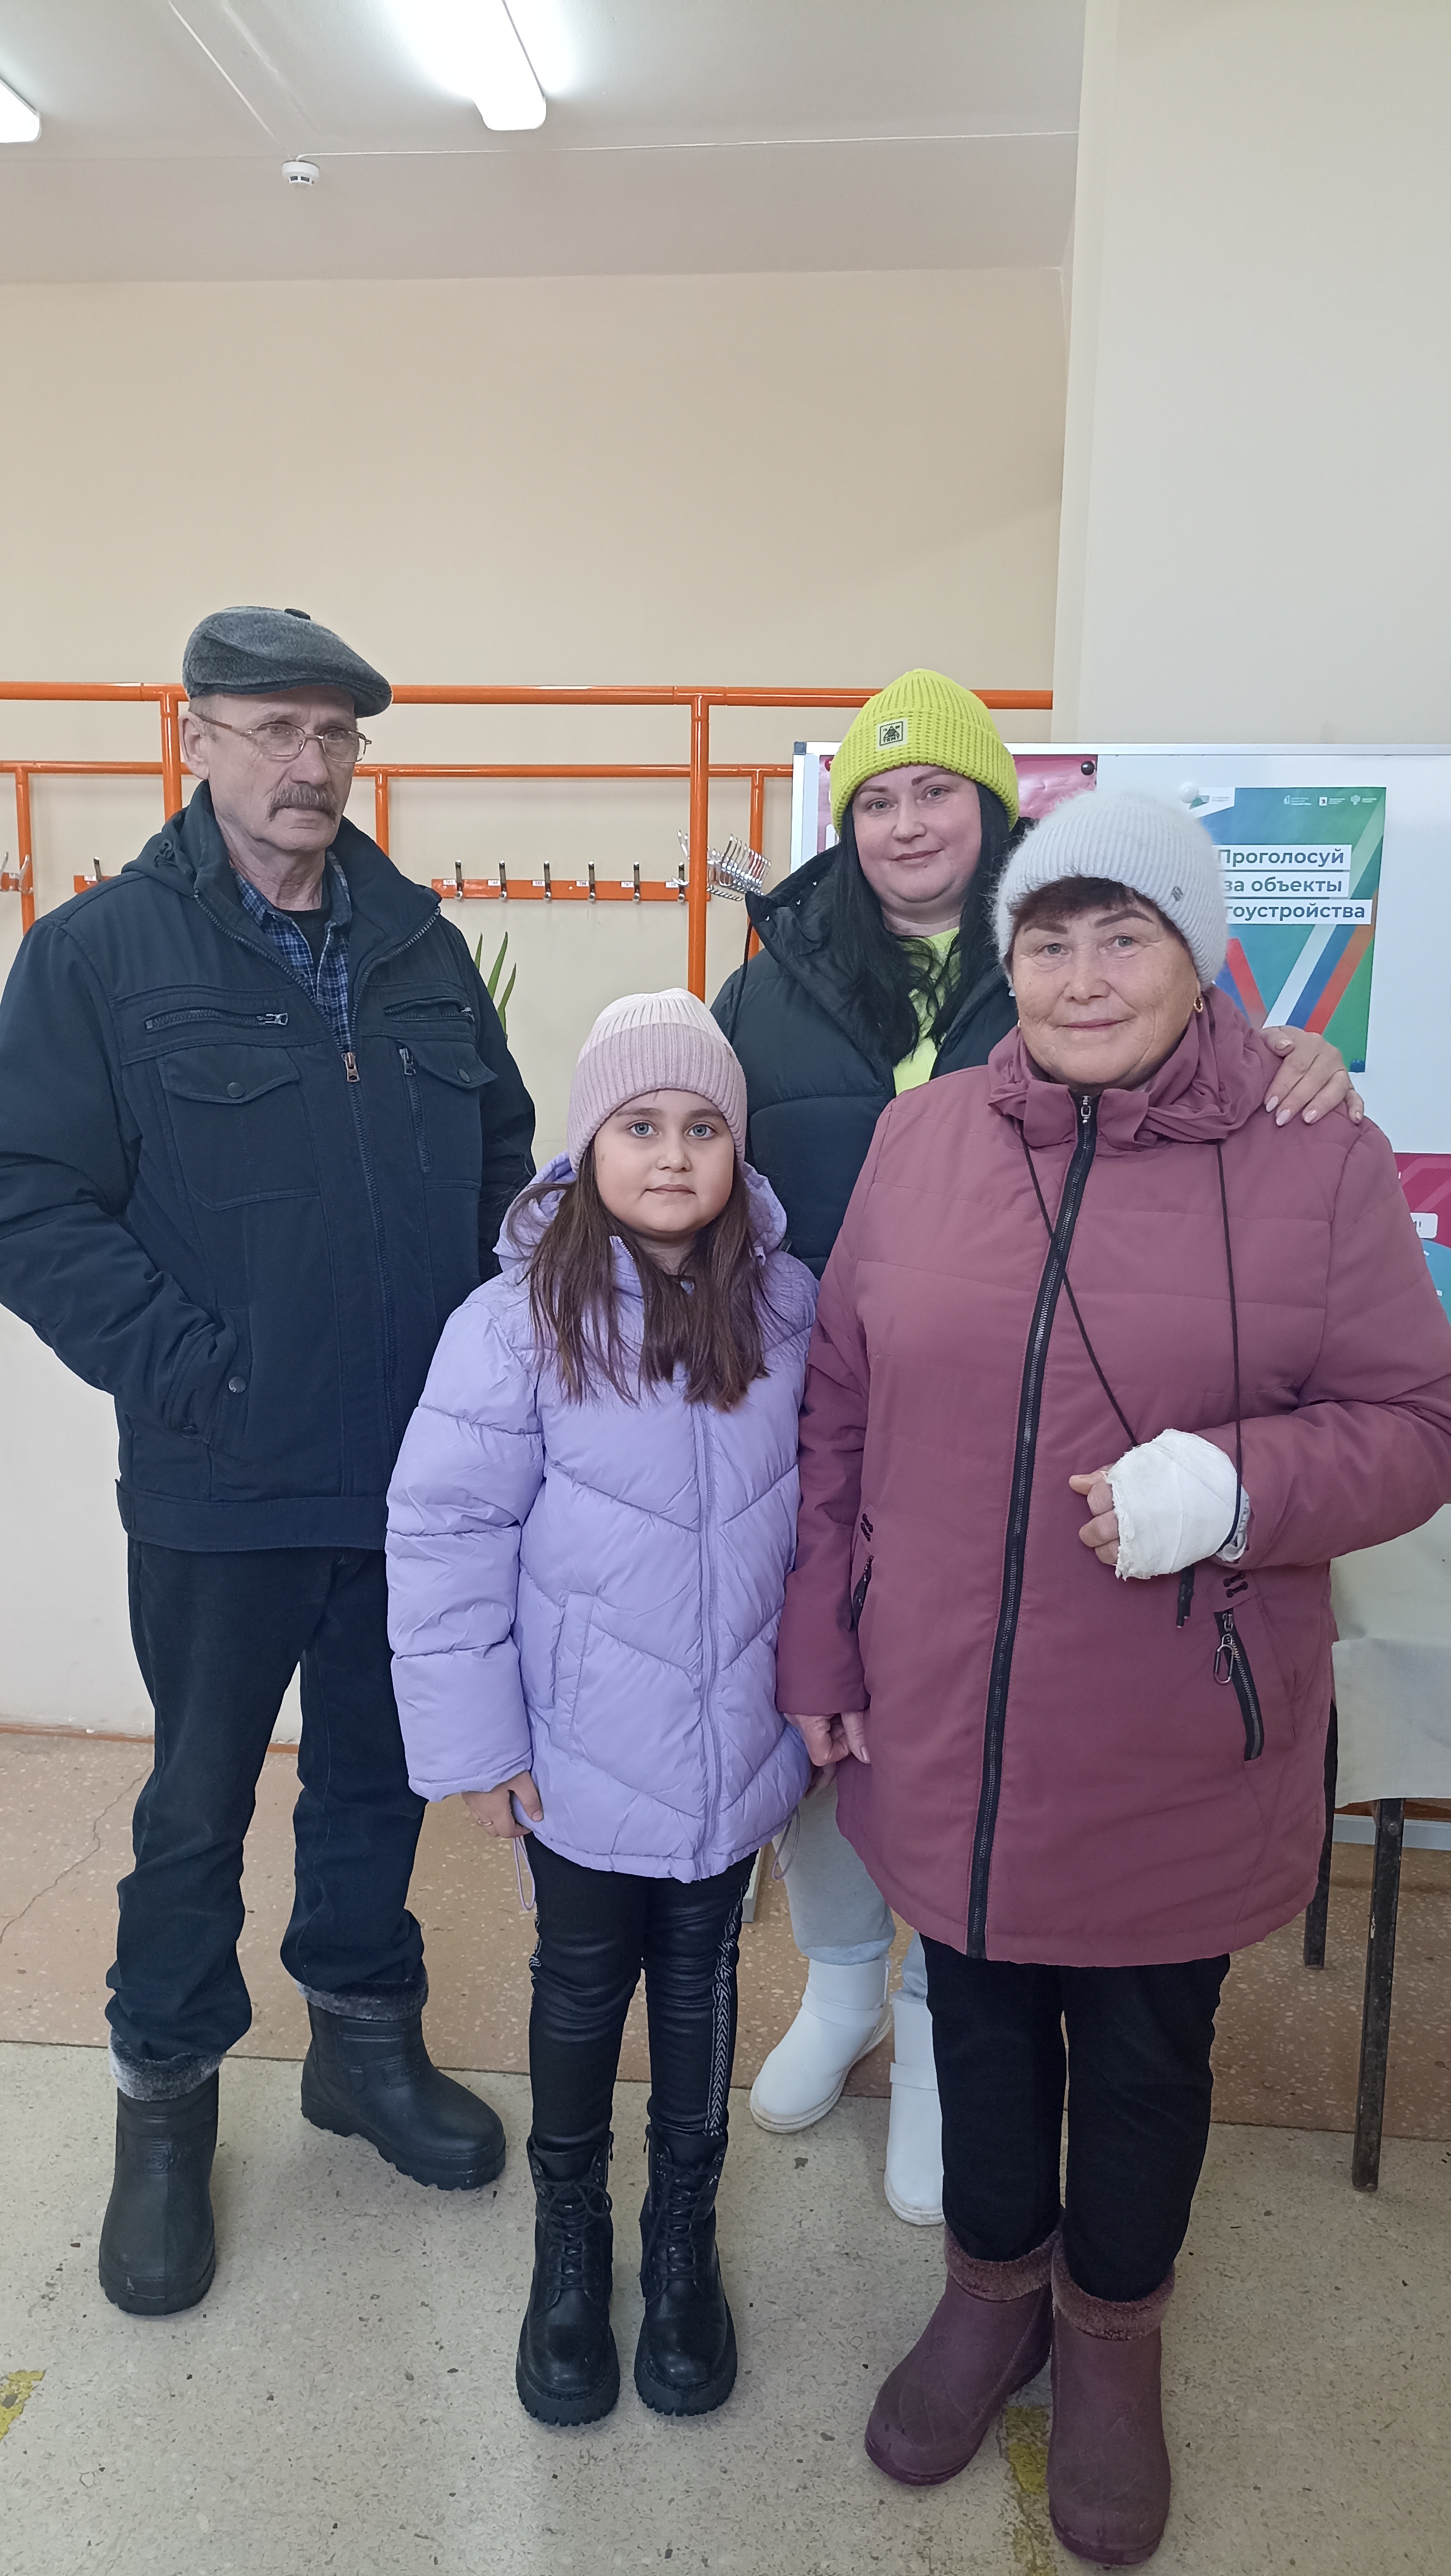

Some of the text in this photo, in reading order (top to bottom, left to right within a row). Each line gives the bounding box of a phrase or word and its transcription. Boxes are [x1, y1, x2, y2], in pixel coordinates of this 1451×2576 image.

[1217, 848, 1343, 867] Проголосуй
[1223, 876, 1342, 892] за объекты
